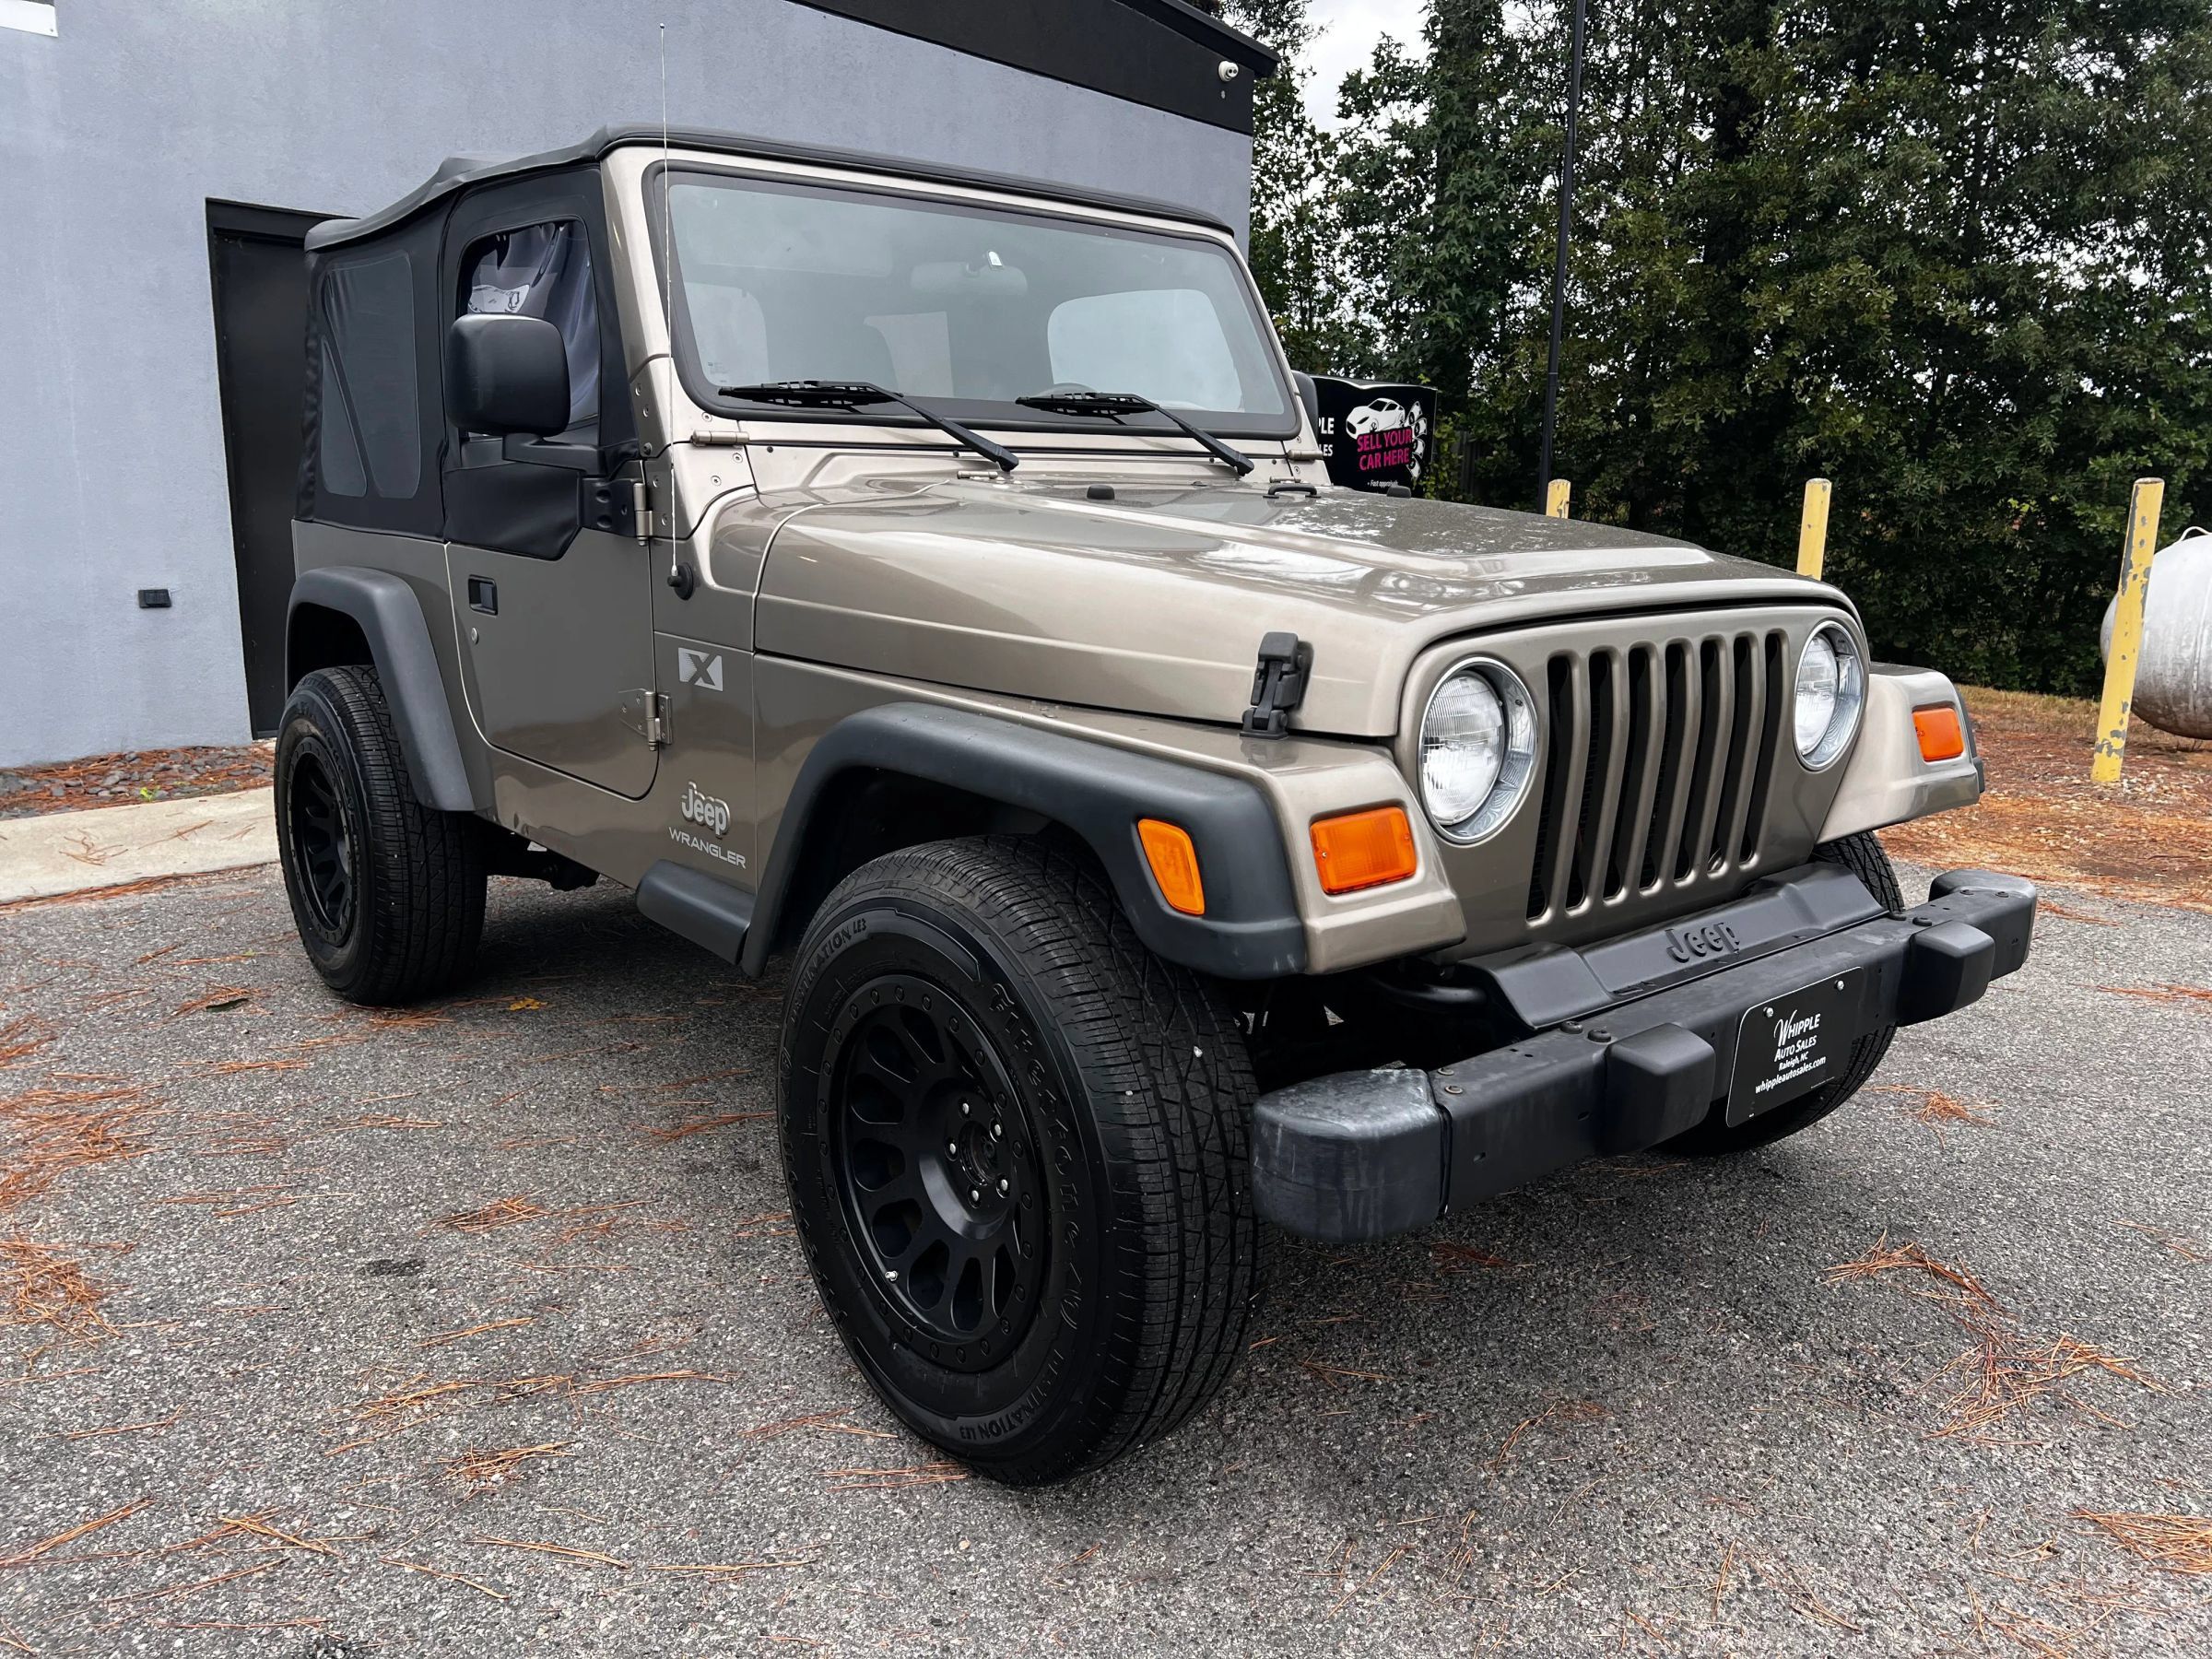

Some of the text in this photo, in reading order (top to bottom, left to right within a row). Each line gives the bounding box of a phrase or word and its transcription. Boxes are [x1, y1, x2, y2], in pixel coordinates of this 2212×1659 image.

[1358, 429, 1412, 452] SELL YOUR
[1359, 448, 1409, 470] CAR HERE
[680, 782, 730, 837] Jeep
[669, 827, 747, 869] WRANGLER
[852, 918, 867, 934] LE3
[1665, 923, 1740, 963] Jeep
[1774, 1009, 1821, 1047] WHIPPLE
[1774, 1035, 1818, 1062] AUTO SALES
[1779, 1052, 1809, 1071] Raleigh, NC
[1755, 1056, 1827, 1094] whippleautosales.com
